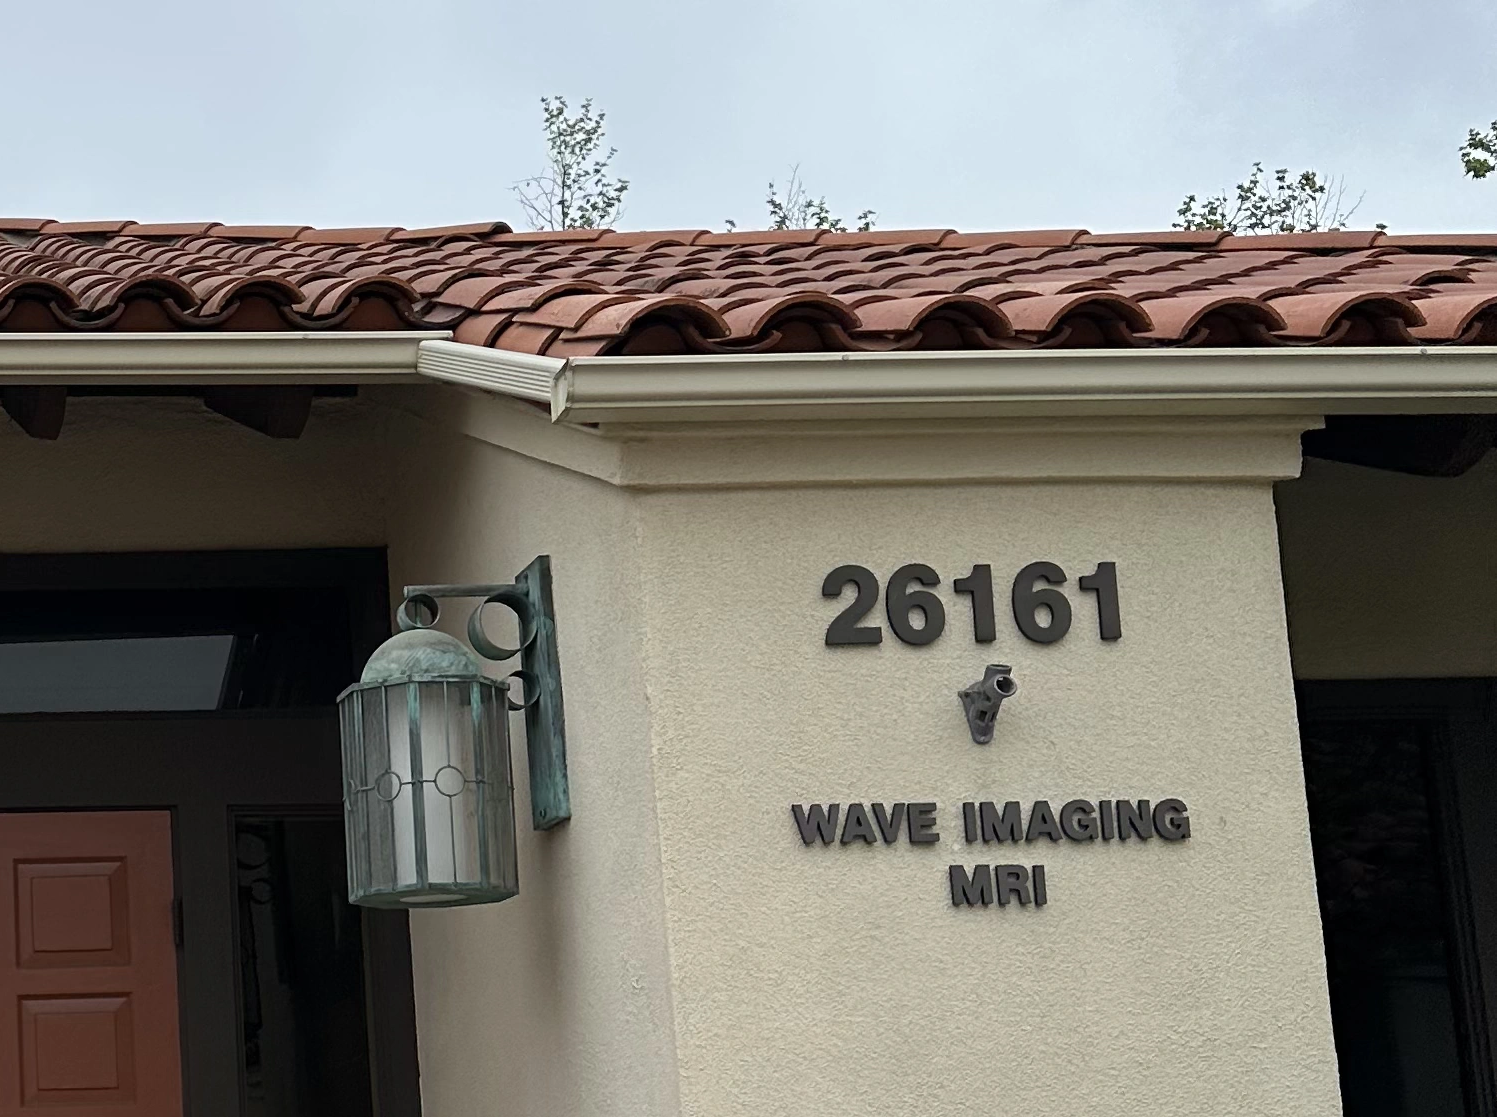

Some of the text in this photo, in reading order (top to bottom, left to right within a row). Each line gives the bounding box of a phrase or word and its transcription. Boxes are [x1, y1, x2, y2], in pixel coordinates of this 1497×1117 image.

[822, 561, 1122, 646] 26161
[791, 798, 1191, 845] WAVE IMAGING
[949, 864, 1047, 908] MRI
